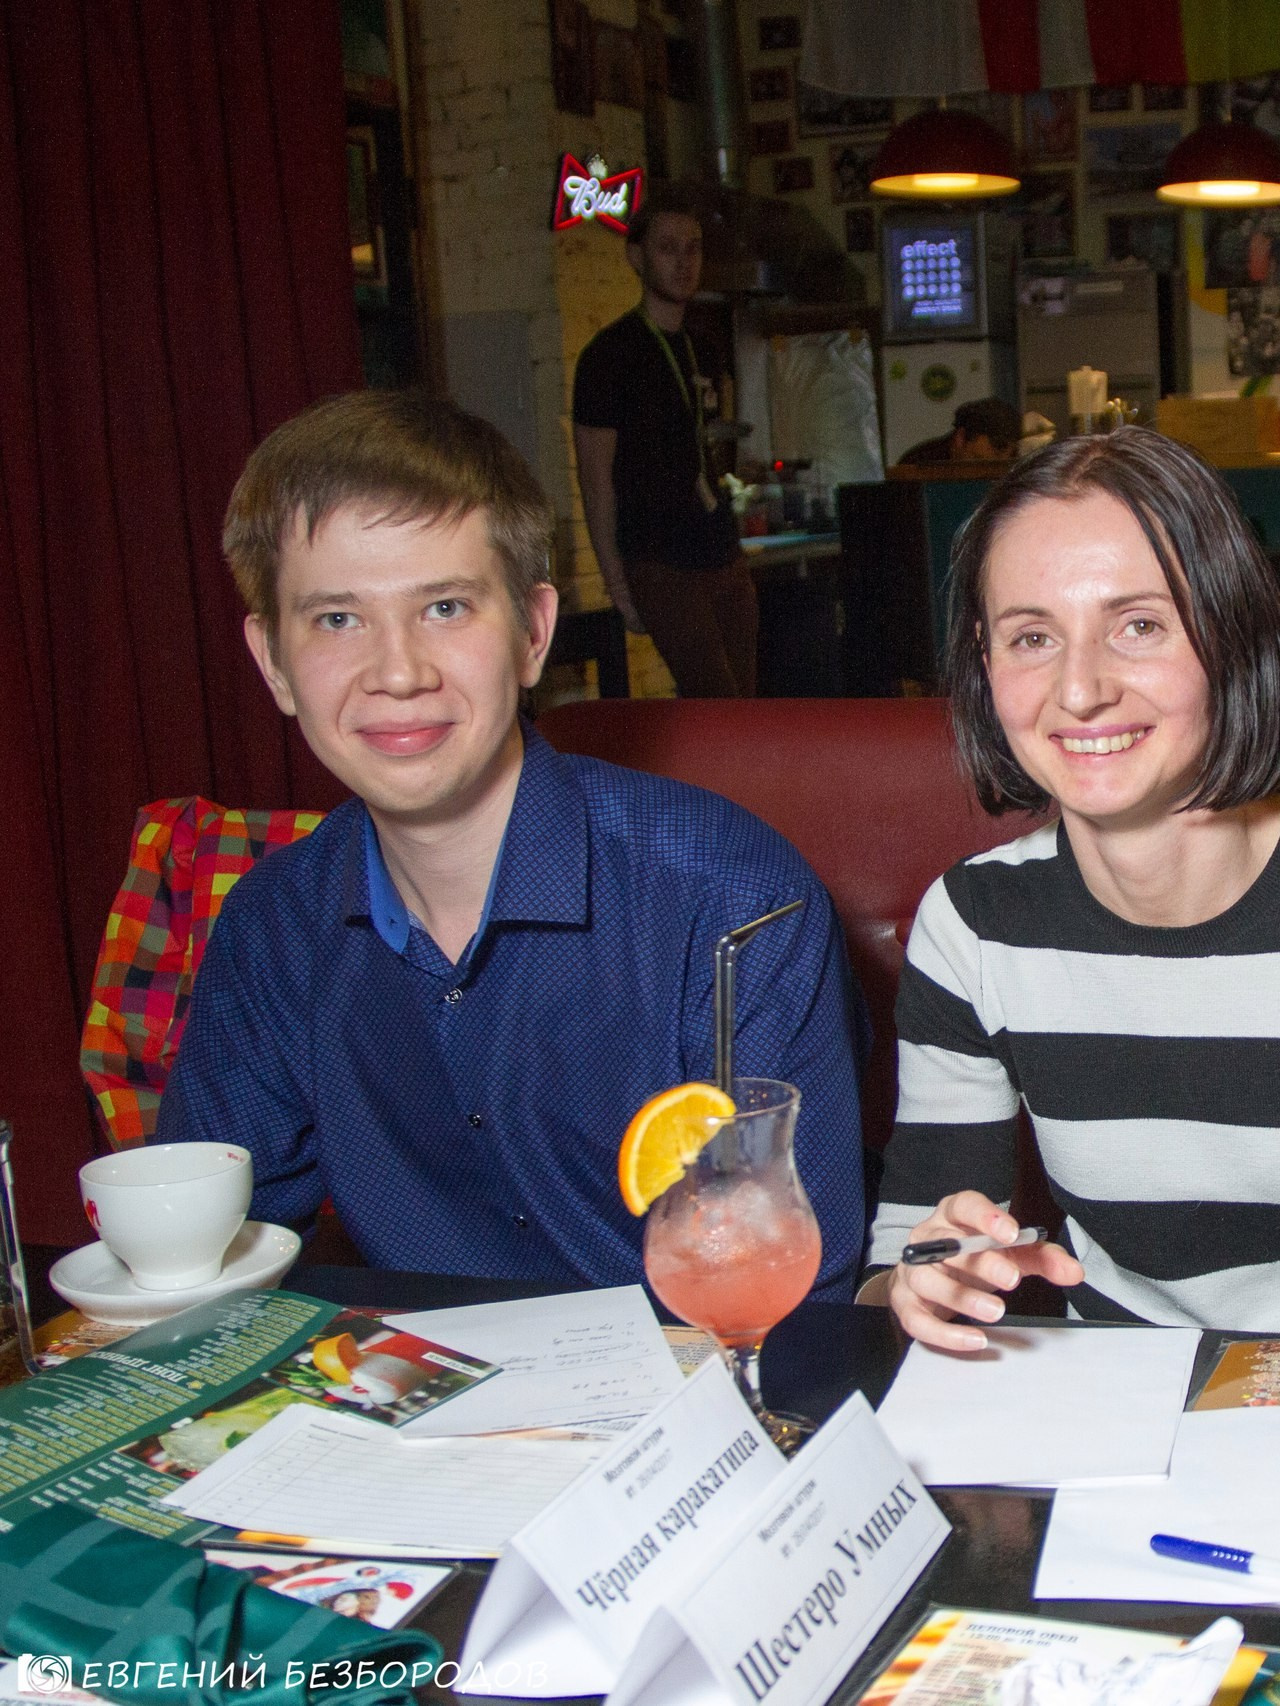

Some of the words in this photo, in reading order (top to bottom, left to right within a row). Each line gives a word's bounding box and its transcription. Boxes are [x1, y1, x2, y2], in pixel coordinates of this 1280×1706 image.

[563, 175, 628, 219] Bud
[901, 239, 957, 258] effect
[576, 1532, 661, 1611] Чёрная
[656, 1430, 759, 1542] каракатица
[735, 1569, 847, 1701] Шестеро
[834, 1478, 918, 1576] Умных
